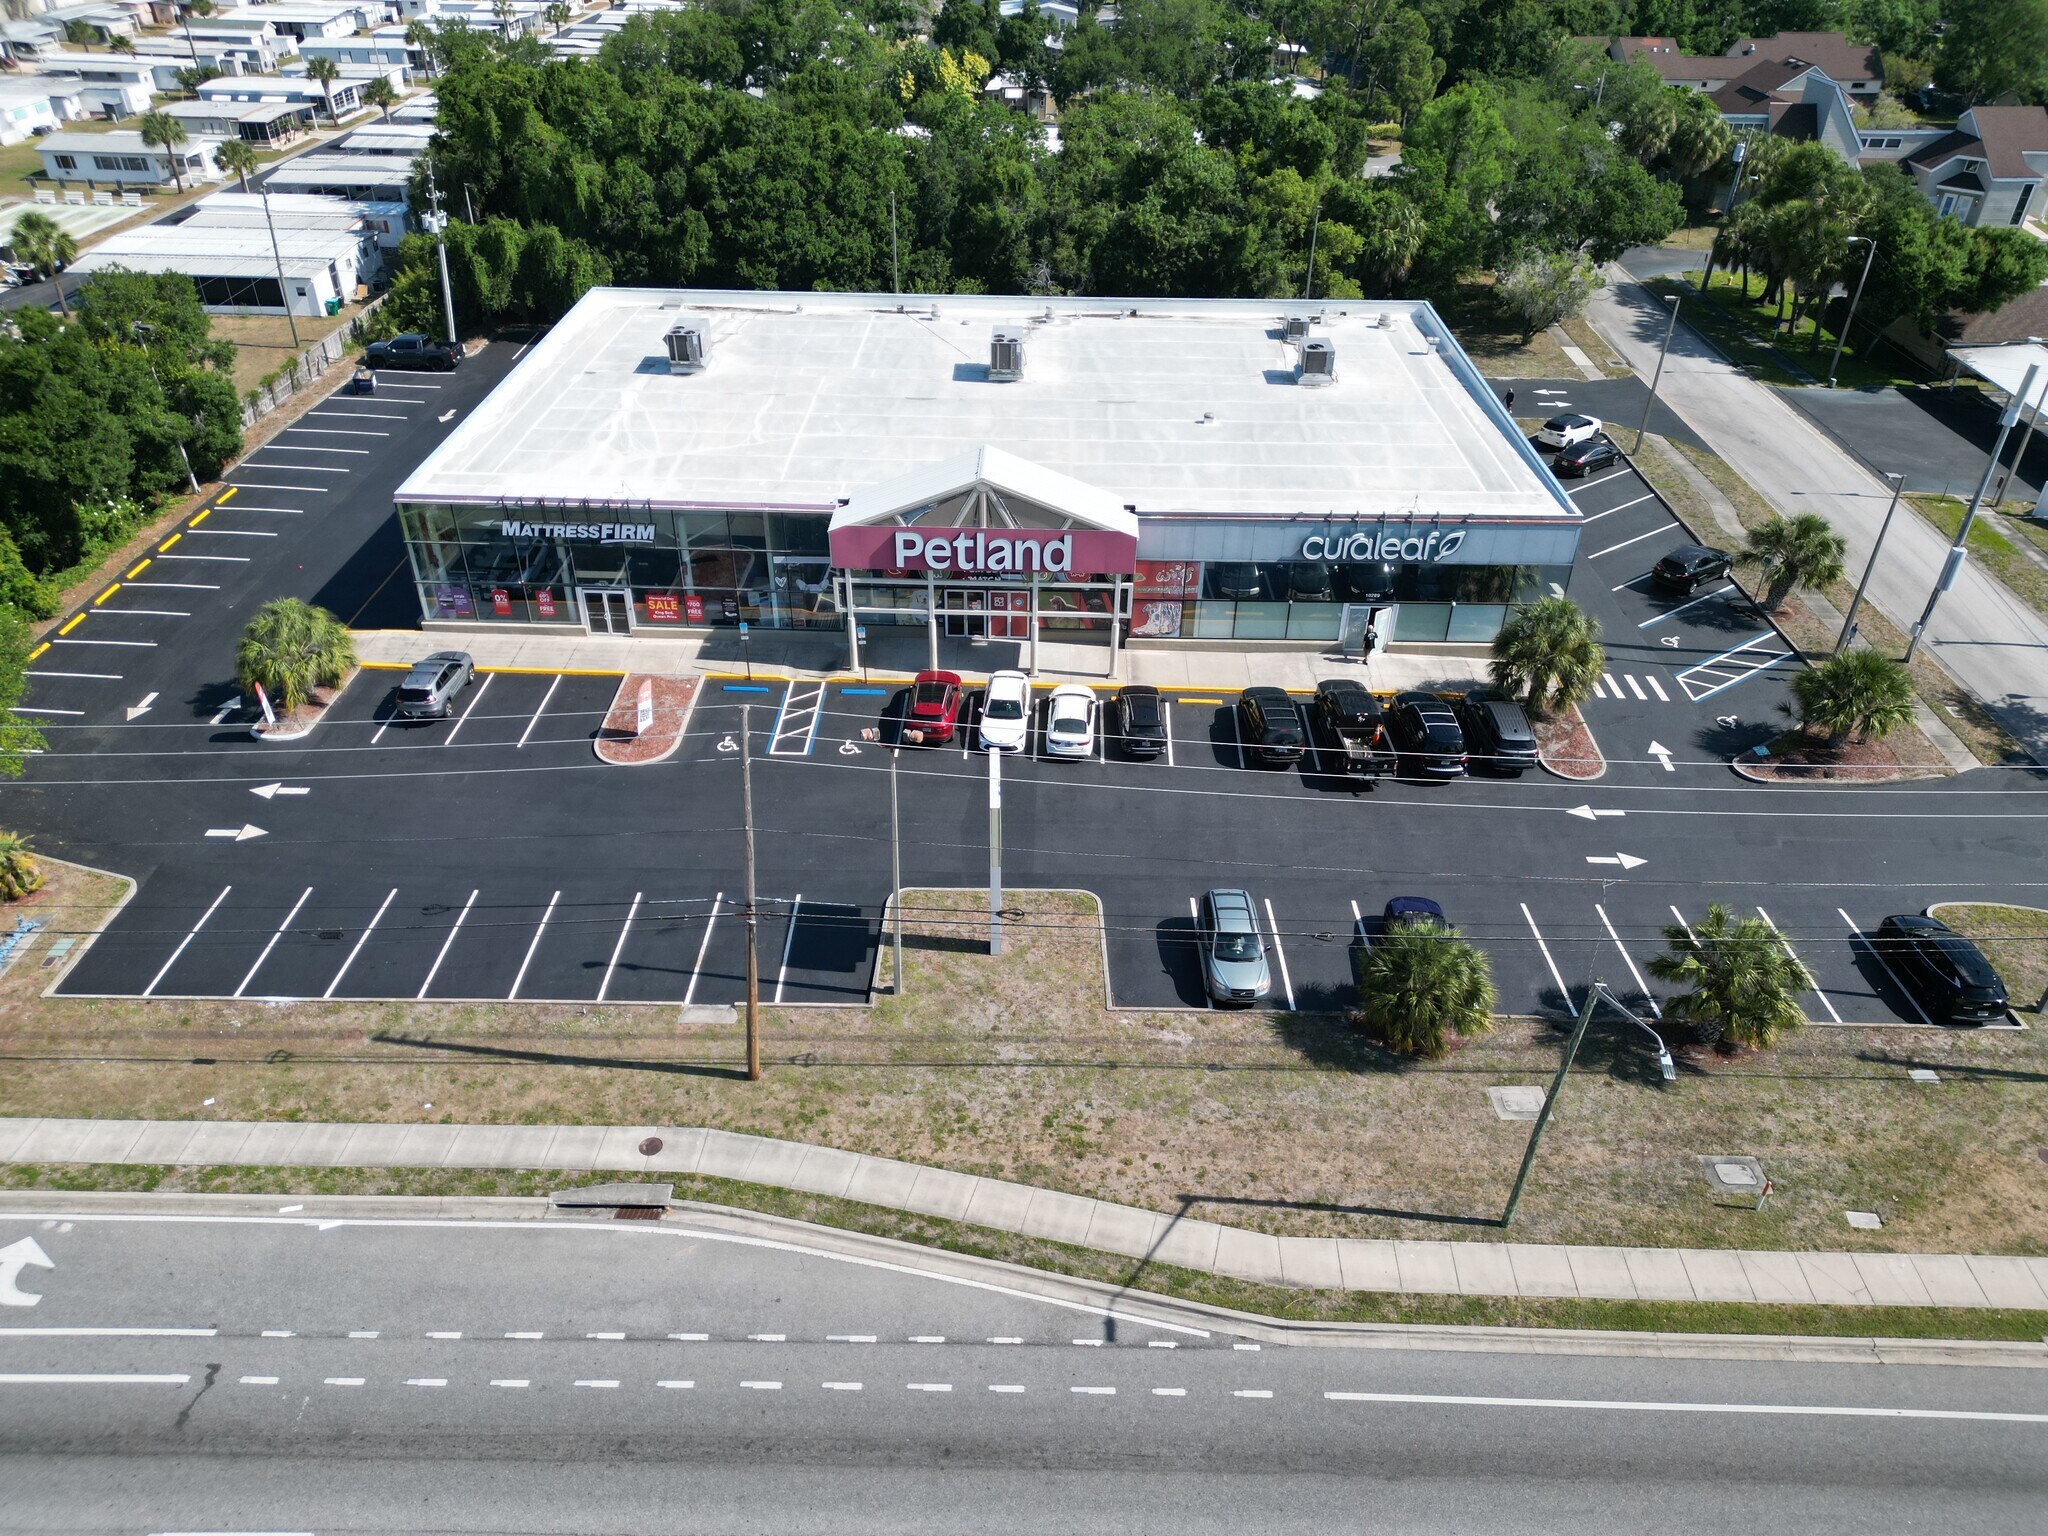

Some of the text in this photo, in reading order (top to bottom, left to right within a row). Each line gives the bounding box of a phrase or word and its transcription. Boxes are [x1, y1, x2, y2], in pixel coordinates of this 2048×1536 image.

[895, 531, 1073, 572] Petland
[1303, 531, 1440, 561] curaleaf
[495, 594, 507, 602] 0%
[648, 600, 678, 610] SALE
